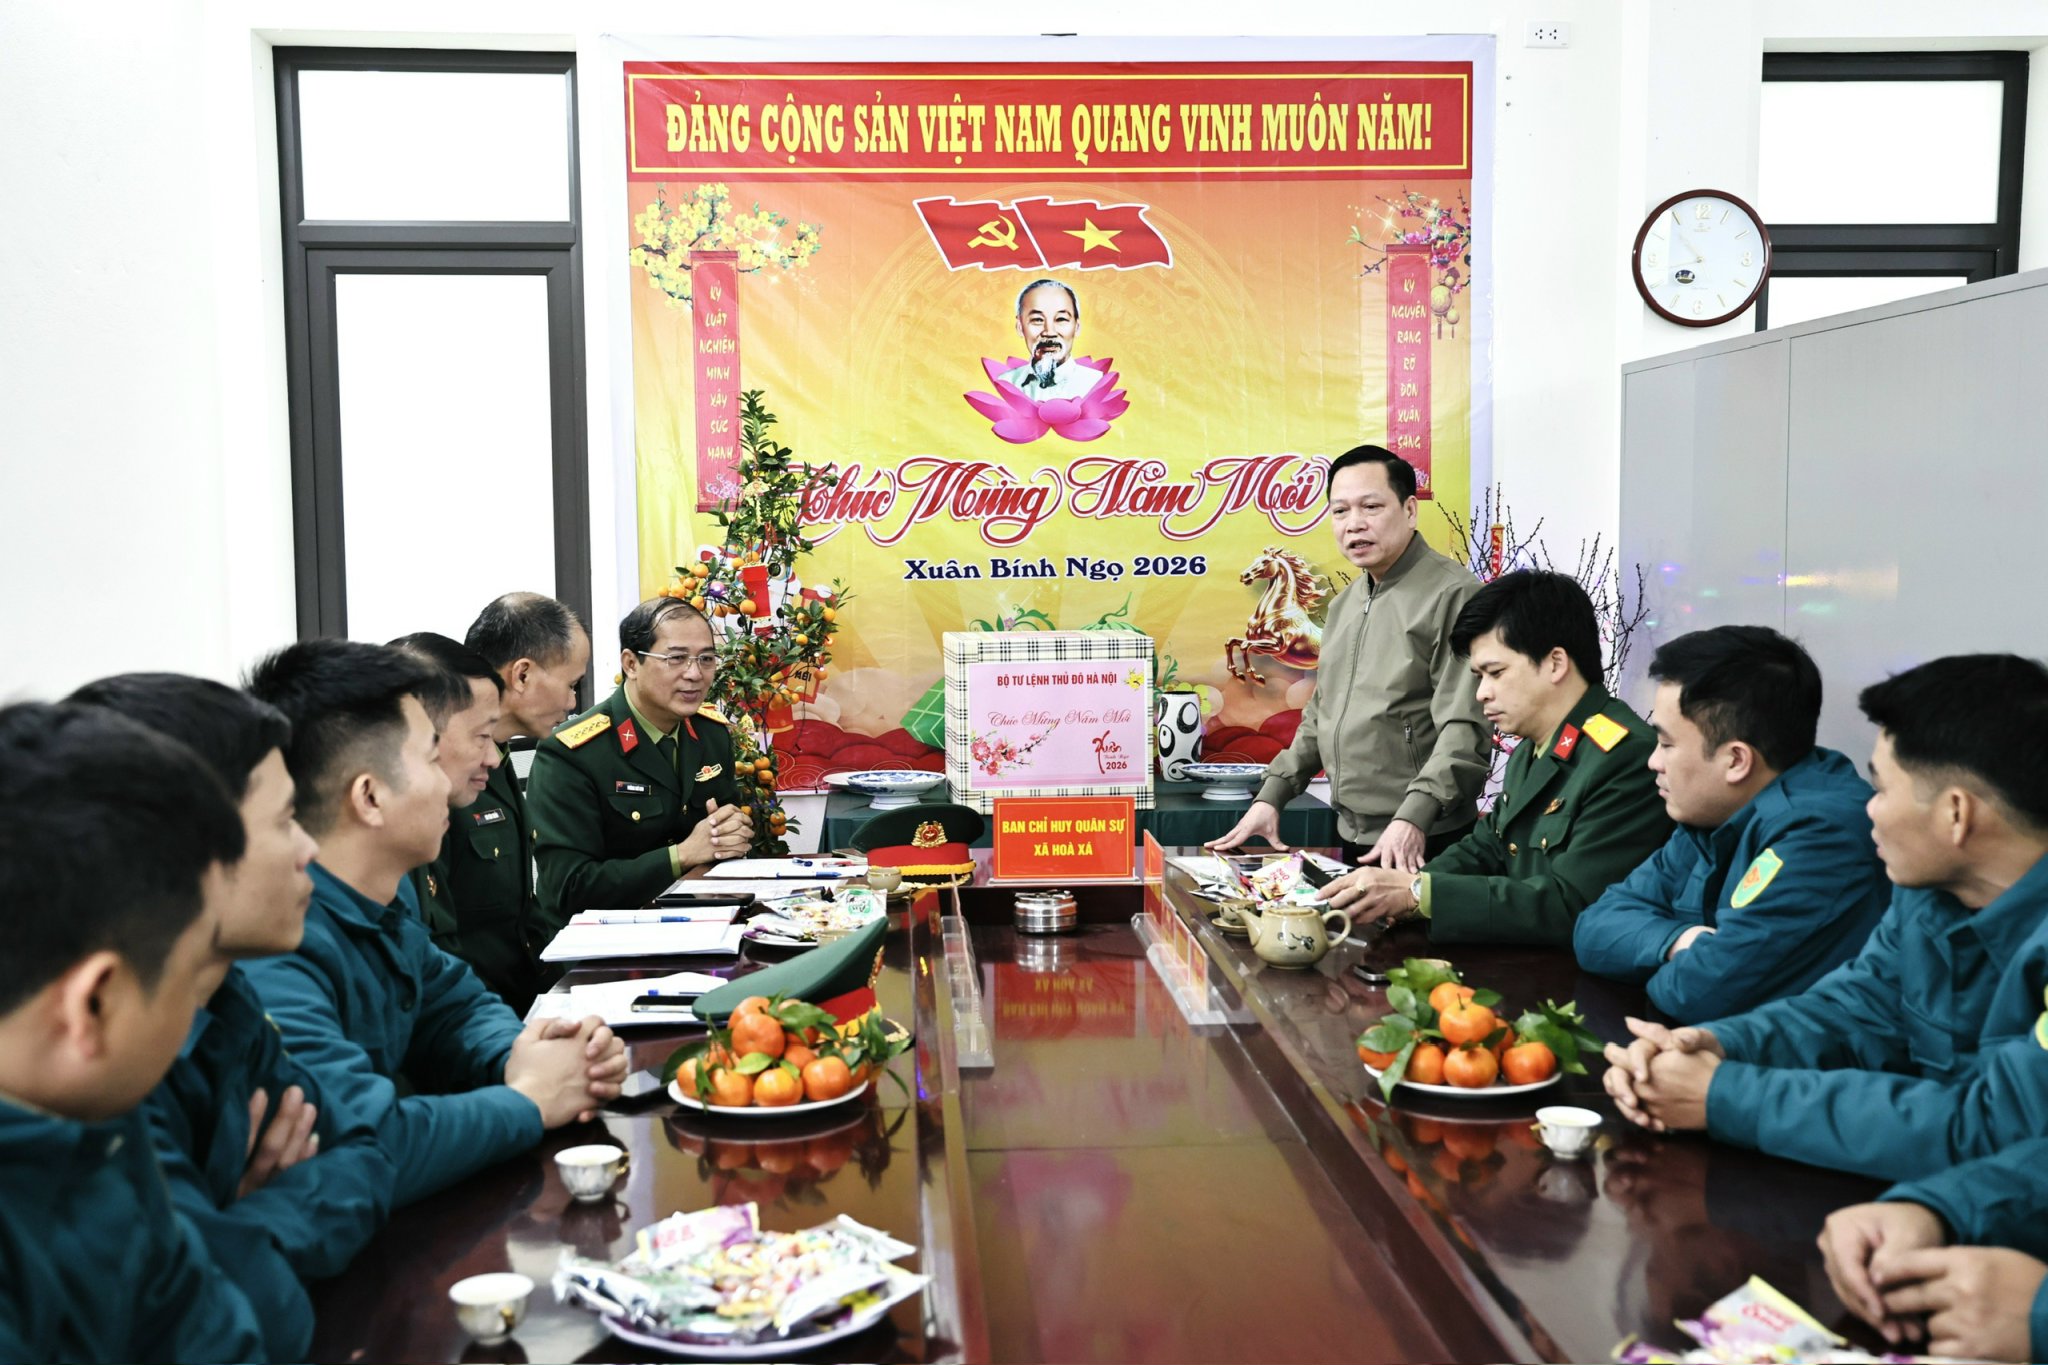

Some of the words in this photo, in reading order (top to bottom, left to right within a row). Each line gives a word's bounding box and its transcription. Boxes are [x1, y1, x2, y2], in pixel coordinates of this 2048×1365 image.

[666, 91, 750, 153] ĐẢNG
[760, 92, 845, 164] CỘNG
[854, 91, 909, 153] SẢN
[918, 93, 986, 164] VIỆT
[995, 104, 1062, 152] NAM
[1071, 103, 1171, 166] QUANG
[1180, 103, 1252, 152] VINH
[1261, 92, 1348, 151] MUÔN
[1357, 92, 1432, 151] NĂM!
[1391, 300, 1427, 320] NGUYÊN
[699, 335, 735, 354] NGHIÊM
[706, 366, 730, 380] MINH
[710, 388, 728, 409] XÂY
[1397, 404, 1420, 423] XUÂN
[1397, 435, 1421, 449] SANG
[865, 455, 1062, 547] Mừng
[1065, 457, 1206, 519] Năm
[1160, 455, 1333, 540] Mới
[904, 559, 981, 580] Xuân
[990, 557, 1057, 578] Bính
[1066, 557, 1124, 581] Ngọ
[1133, 556, 1207, 576] 2026
[997, 674, 1009, 688] BỘ
[1012, 675, 1024, 686] TƯ
[1026, 673, 1049, 687] LỆNH
[1052, 671, 1069, 685] THỦ
[1071, 672, 1084, 684] ĐÔ
[1086, 671, 1099, 684] HÀ
[1101, 672, 1117, 686] NỘI
[988, 711, 1018, 727] Chúc
[1021, 710, 1061, 730] Mừng
[1065, 709, 1098, 725] Năm
[1106, 761, 1128, 770] 2026
[1002, 820, 1026, 833] BAN
[1028, 816, 1048, 833] CHỈ
[1050, 820, 1072, 833] HUY
[1075, 817, 1106, 834] QUÂN
[1109, 818, 1126, 834] SỰ
[1034, 842, 1050, 856] XÃ
[1052, 841, 1075, 856] HOÀ
[1078, 841, 1093, 856] XÁ
